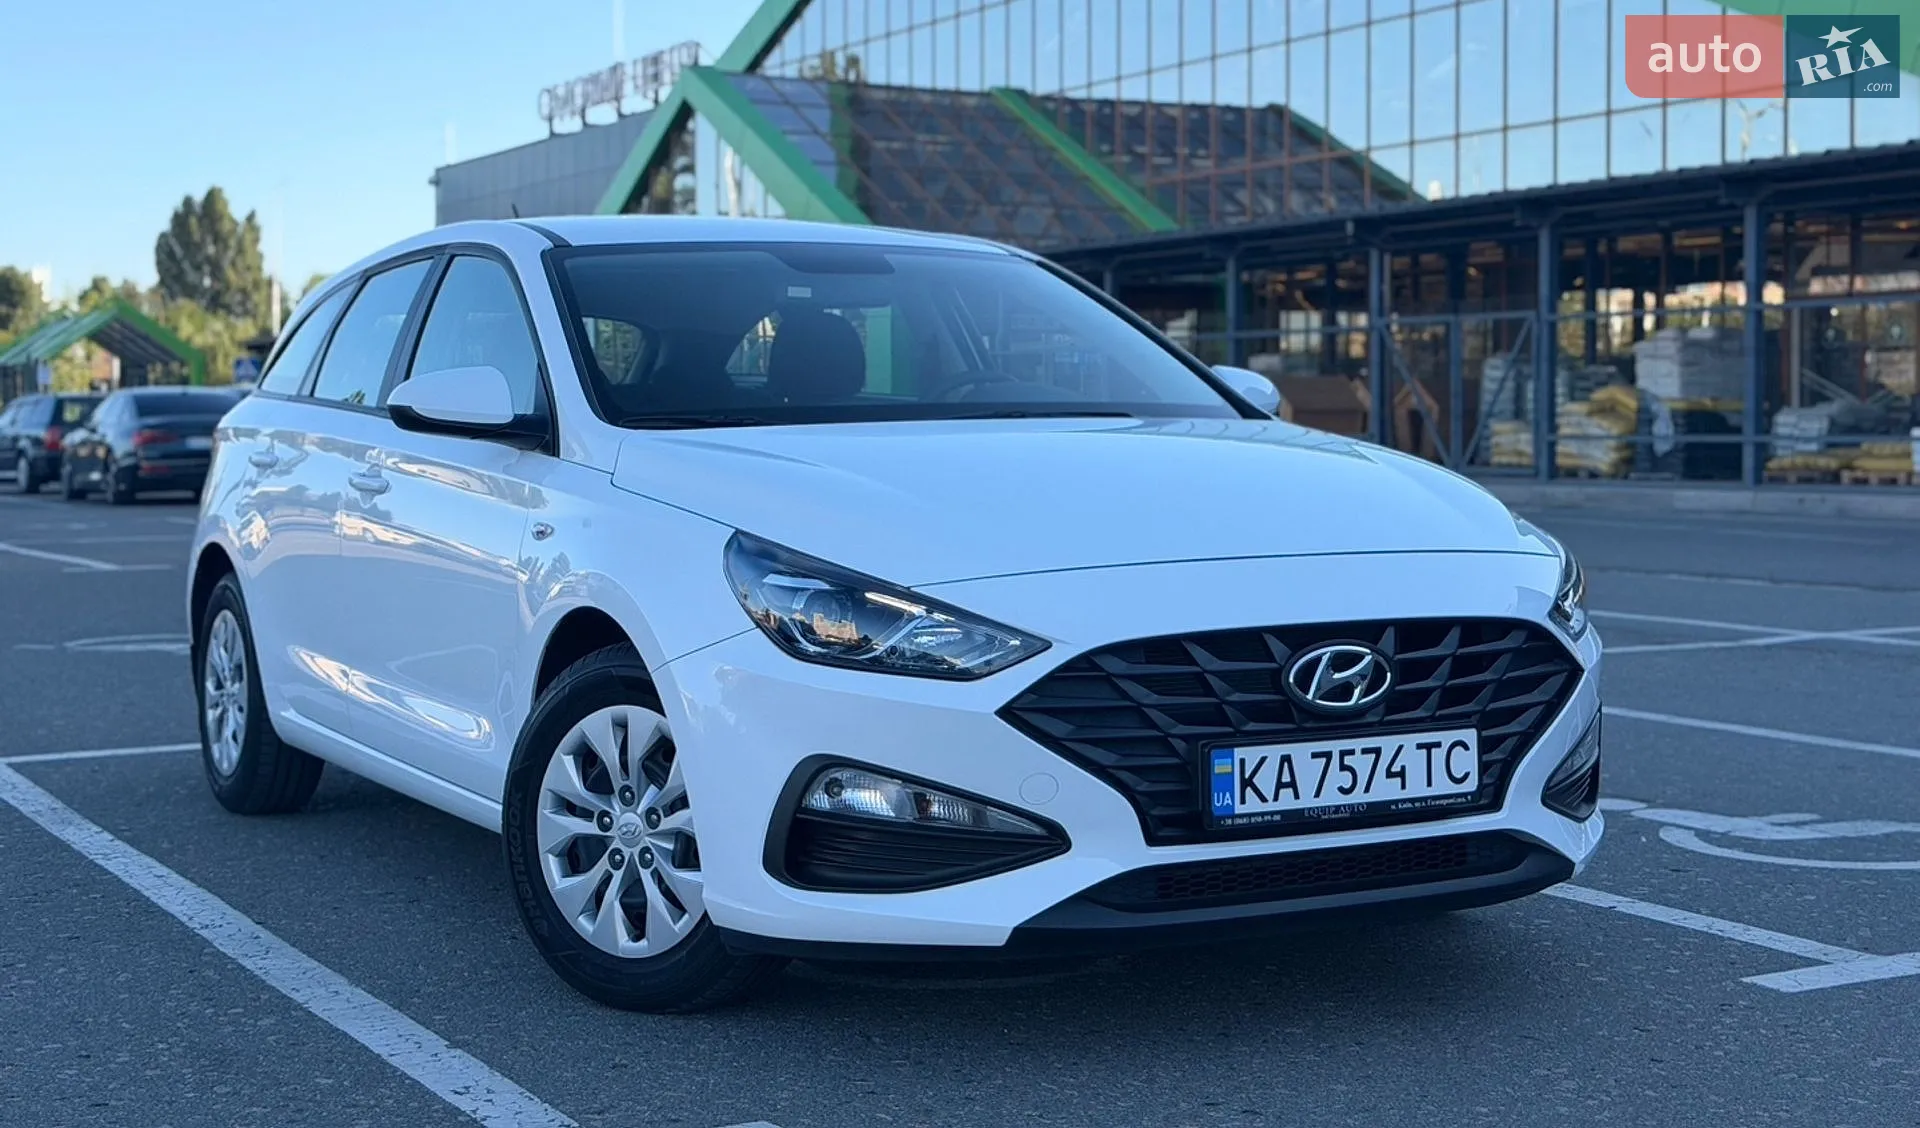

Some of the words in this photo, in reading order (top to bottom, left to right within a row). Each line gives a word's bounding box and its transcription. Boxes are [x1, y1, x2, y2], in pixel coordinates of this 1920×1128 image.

[1239, 754, 1300, 805] KA
[1310, 744, 1407, 799] 7574
[1415, 739, 1471, 788] TC
[1214, 791, 1233, 807] UA
